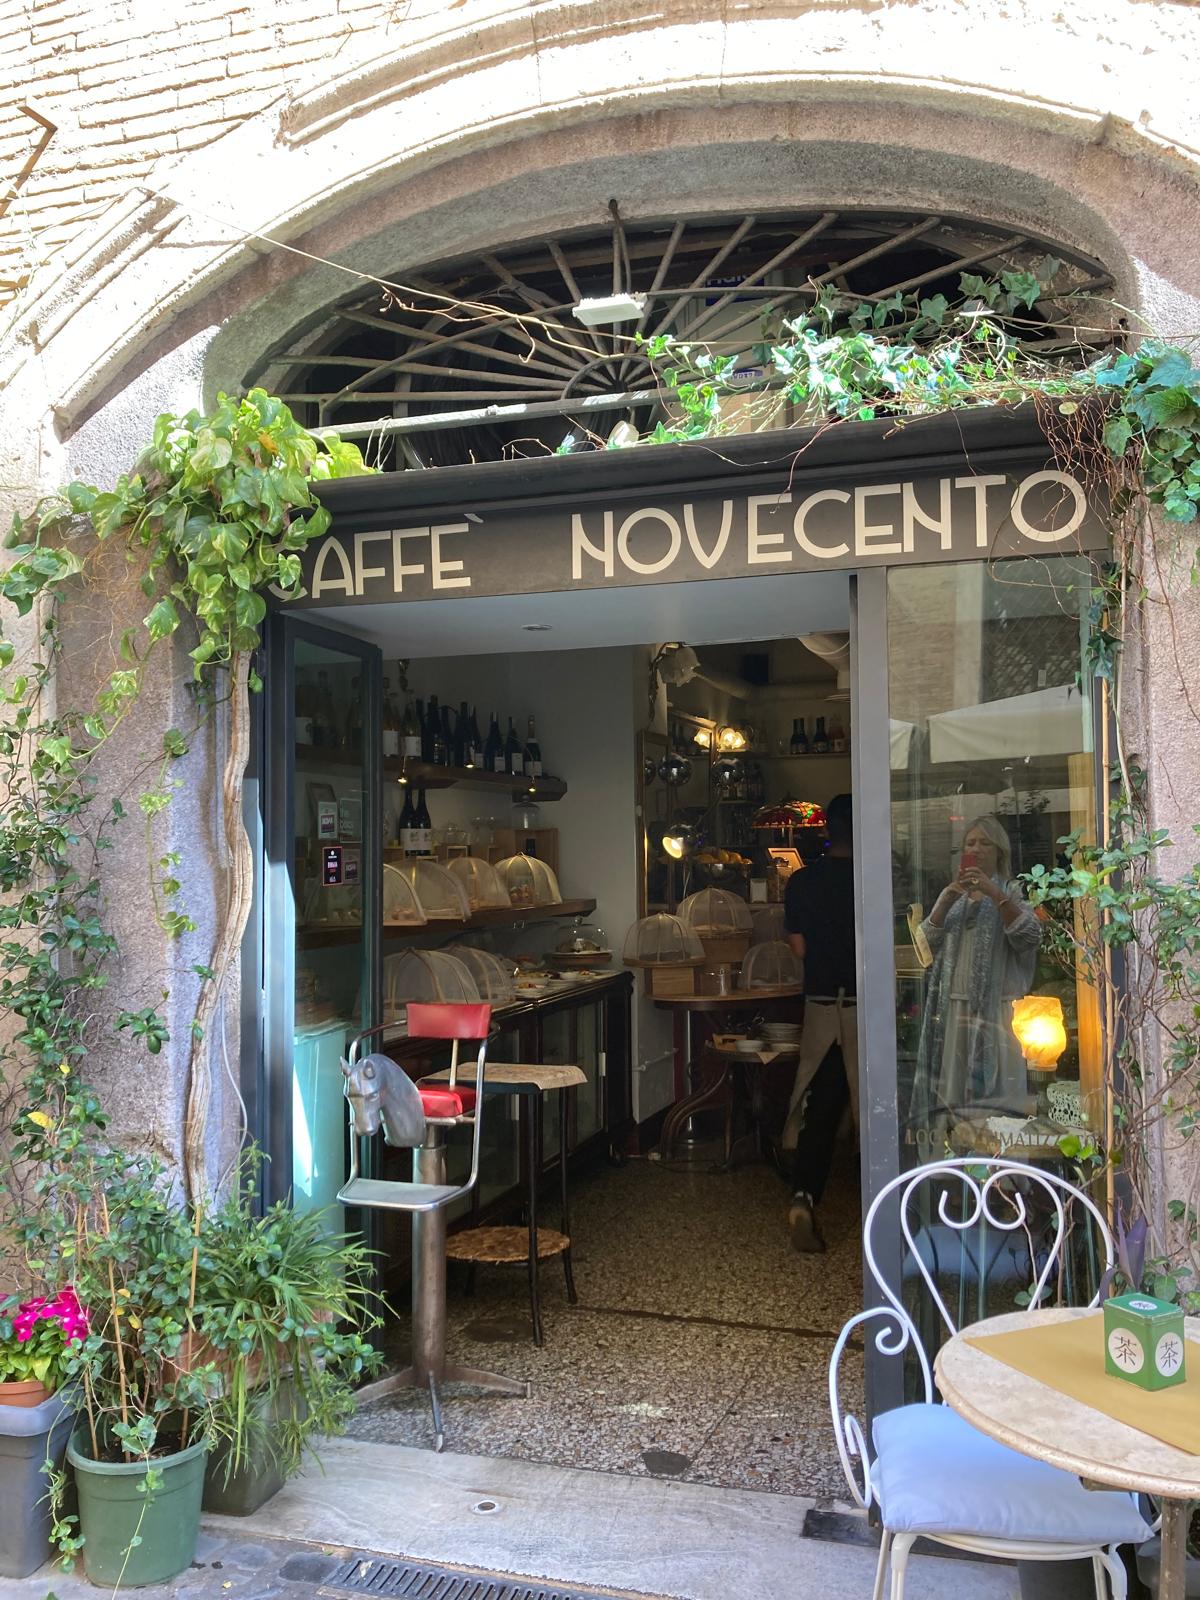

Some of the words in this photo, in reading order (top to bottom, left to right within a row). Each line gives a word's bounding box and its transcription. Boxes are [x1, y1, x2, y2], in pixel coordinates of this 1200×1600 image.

[571, 470, 1088, 580] NOVECENTO
[1113, 1336, 1137, 1366] 茶
[1159, 1340, 1179, 1369] 茶
